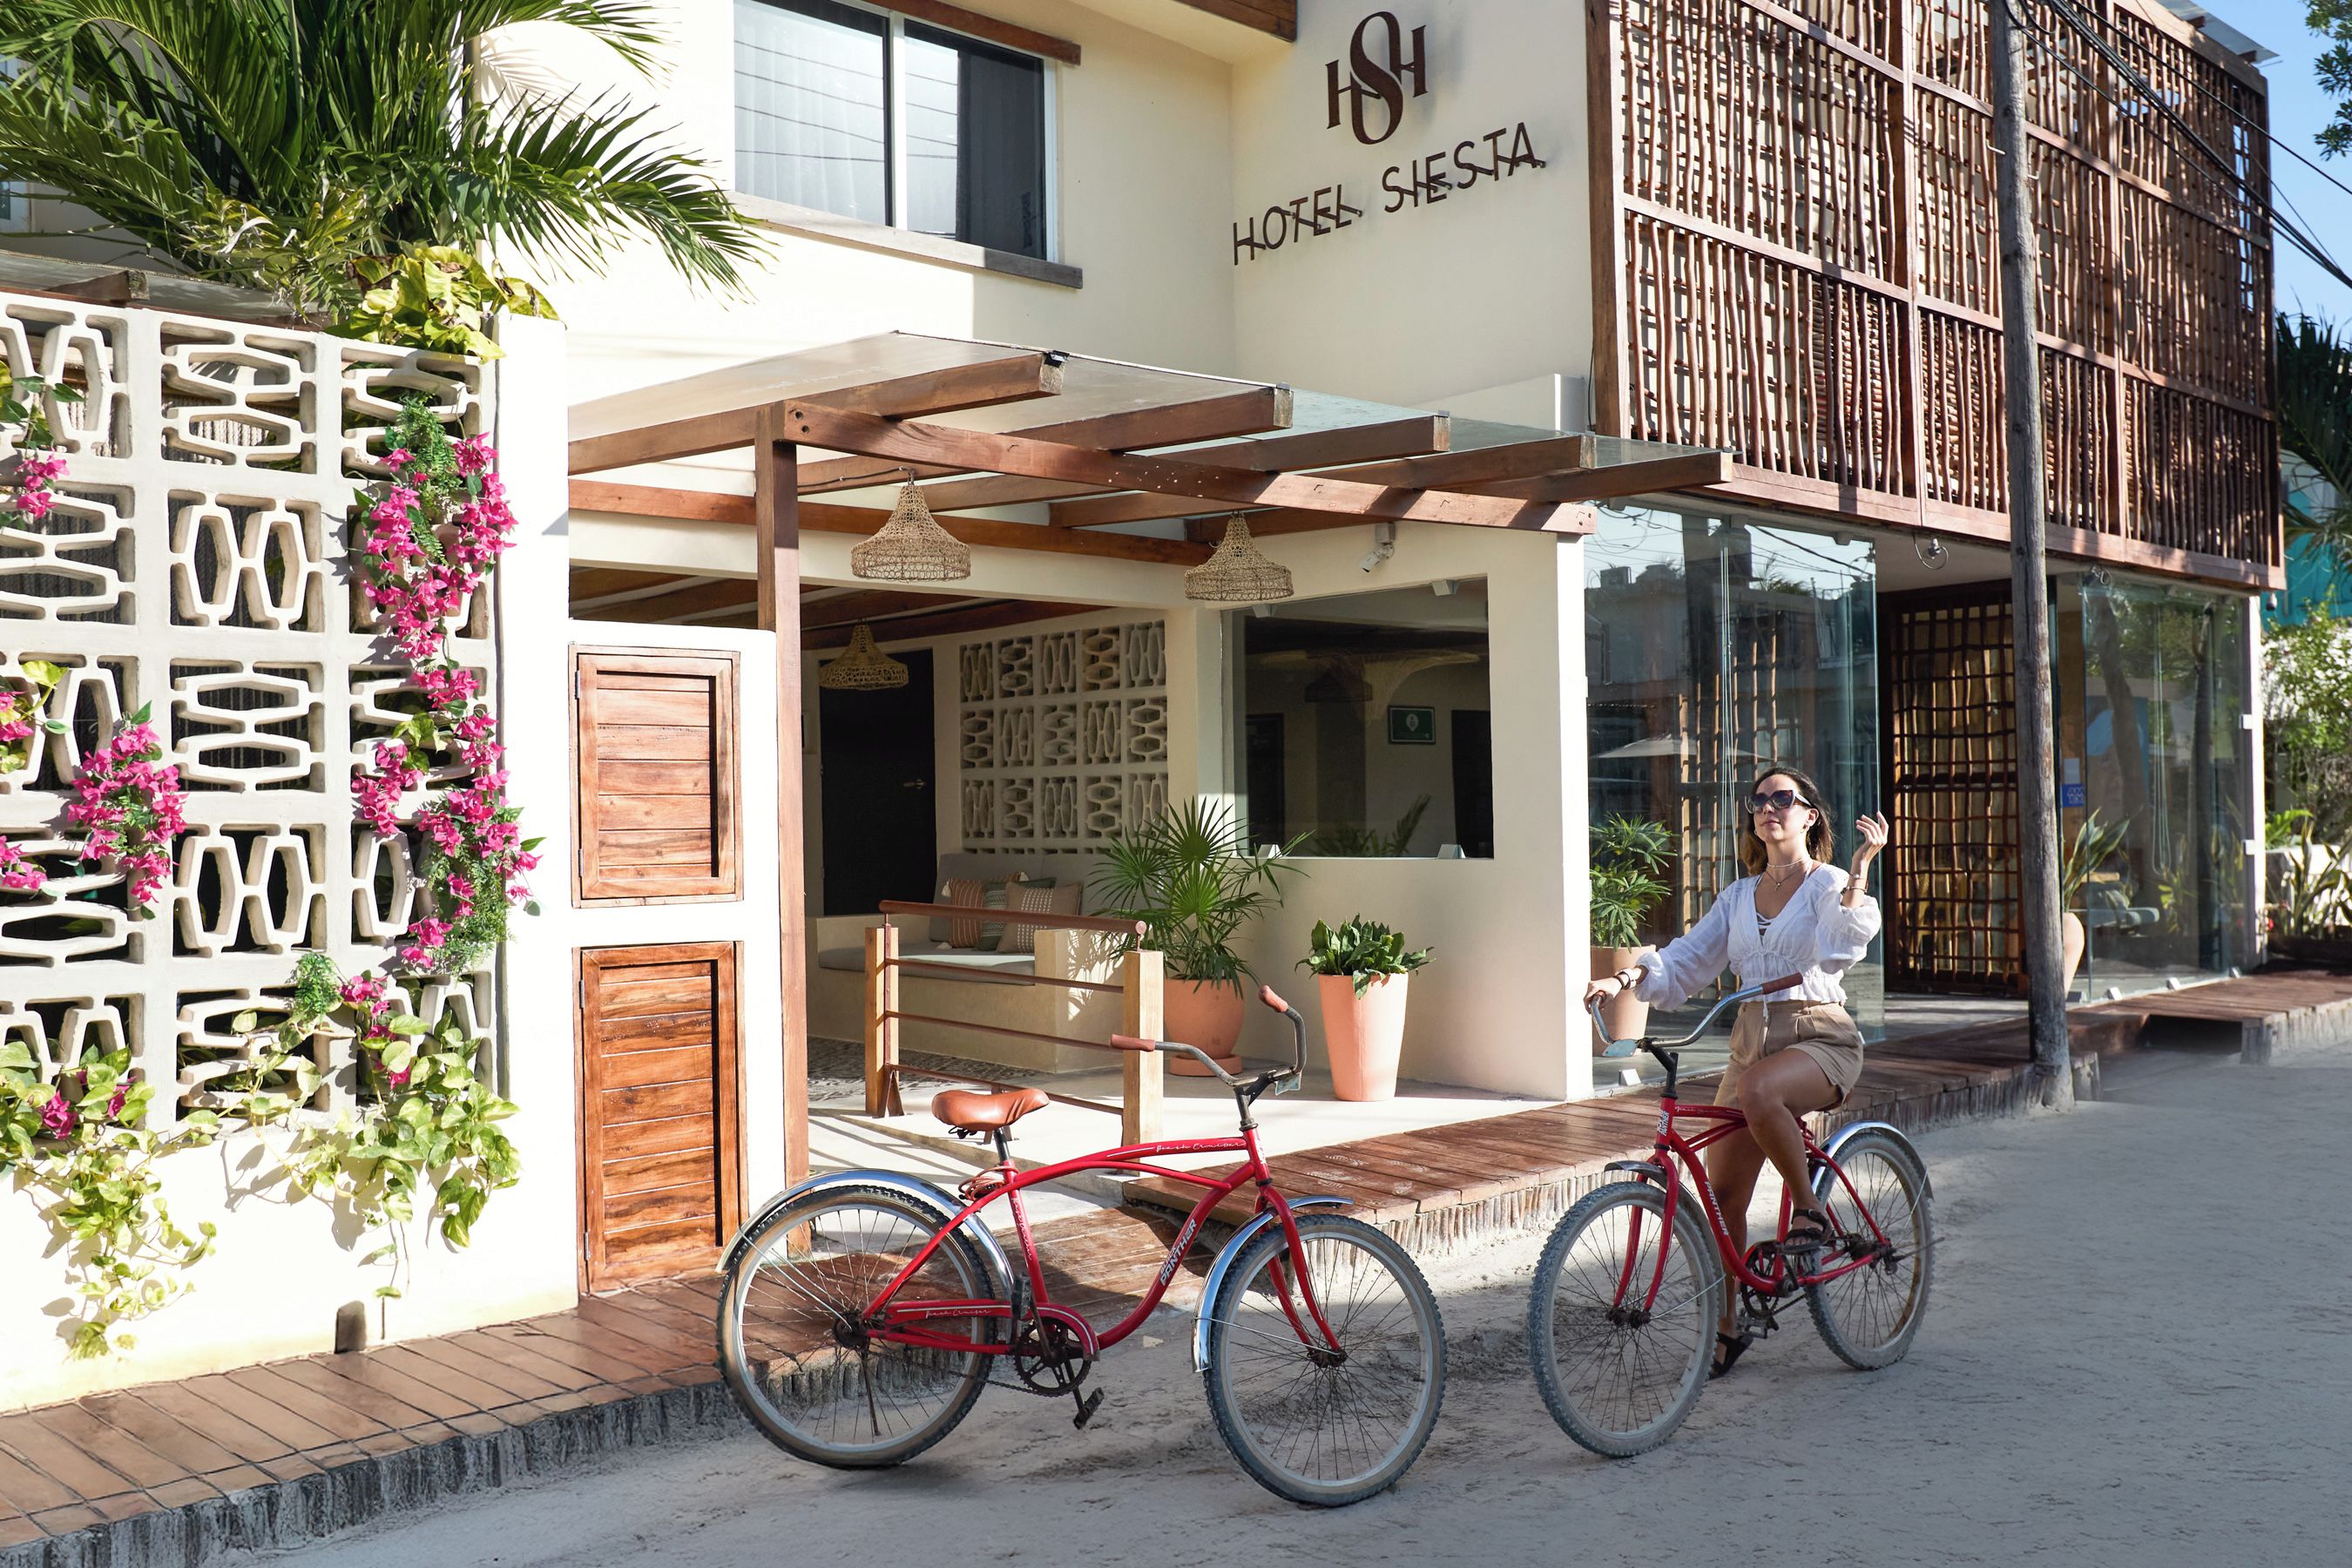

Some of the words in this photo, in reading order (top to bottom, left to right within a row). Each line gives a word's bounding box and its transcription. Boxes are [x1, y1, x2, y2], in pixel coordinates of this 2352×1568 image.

[1233, 184, 1352, 266] HOTEL
[1382, 122, 1538, 213] SIESTA
[1705, 1181, 1729, 1235] PANTHER
[1160, 1219, 1198, 1286] PANTHER
